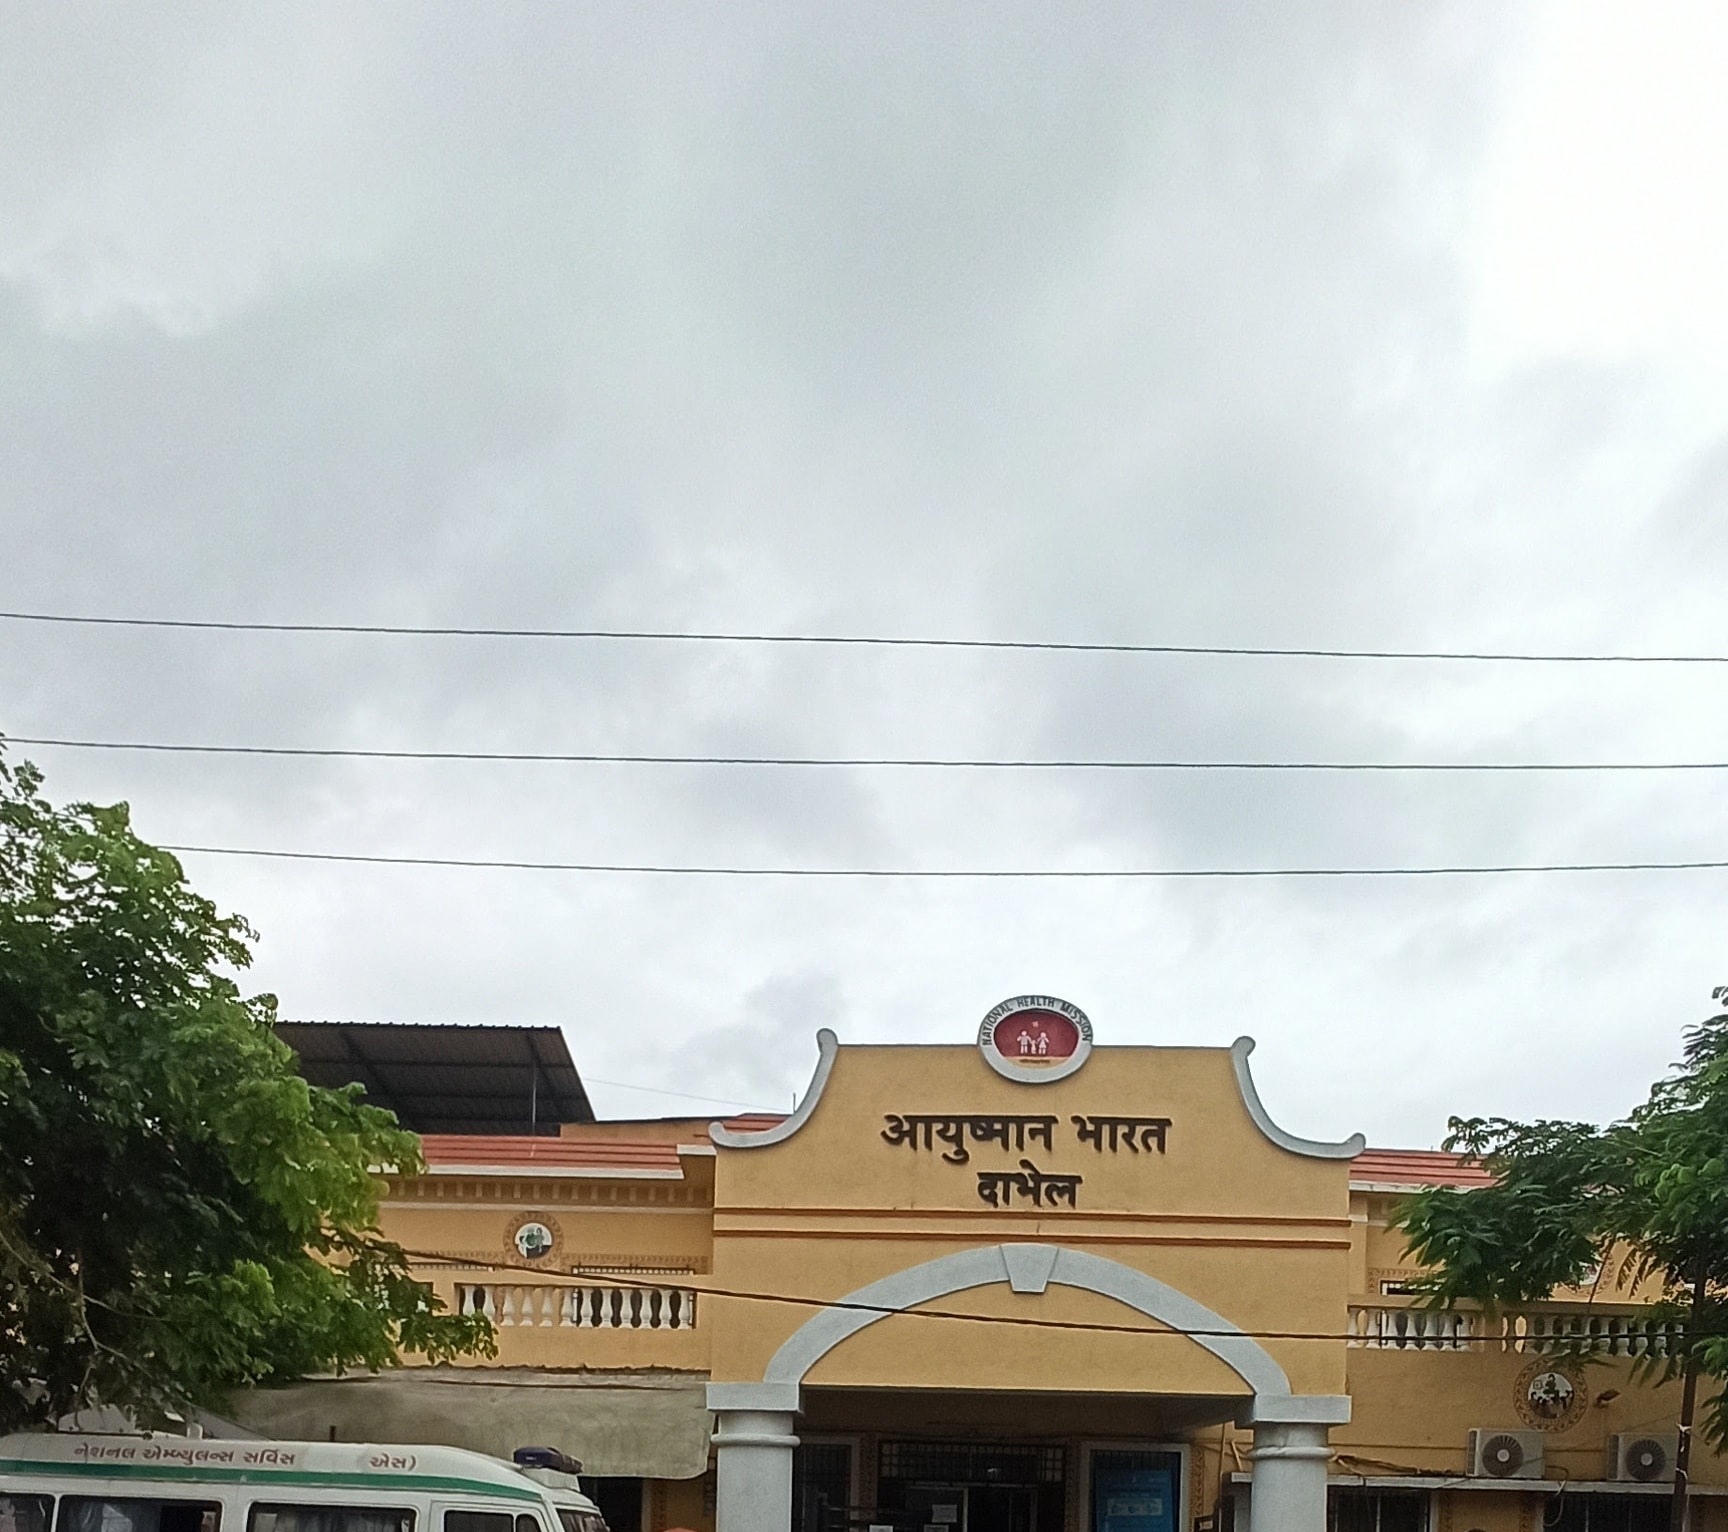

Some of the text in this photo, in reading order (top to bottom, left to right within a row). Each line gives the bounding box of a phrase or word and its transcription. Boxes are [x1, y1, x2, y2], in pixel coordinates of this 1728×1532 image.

[982, 998, 1092, 1046] NATIONAL HEALTH MISSION
[880, 1114, 1173, 1165] आयुष्मान भारत
[976, 1158, 1083, 1209] दाभेल
[74, 1443, 136, 1459] નેશનલ
[243, 1447, 296, 1464] સર્વિસ
